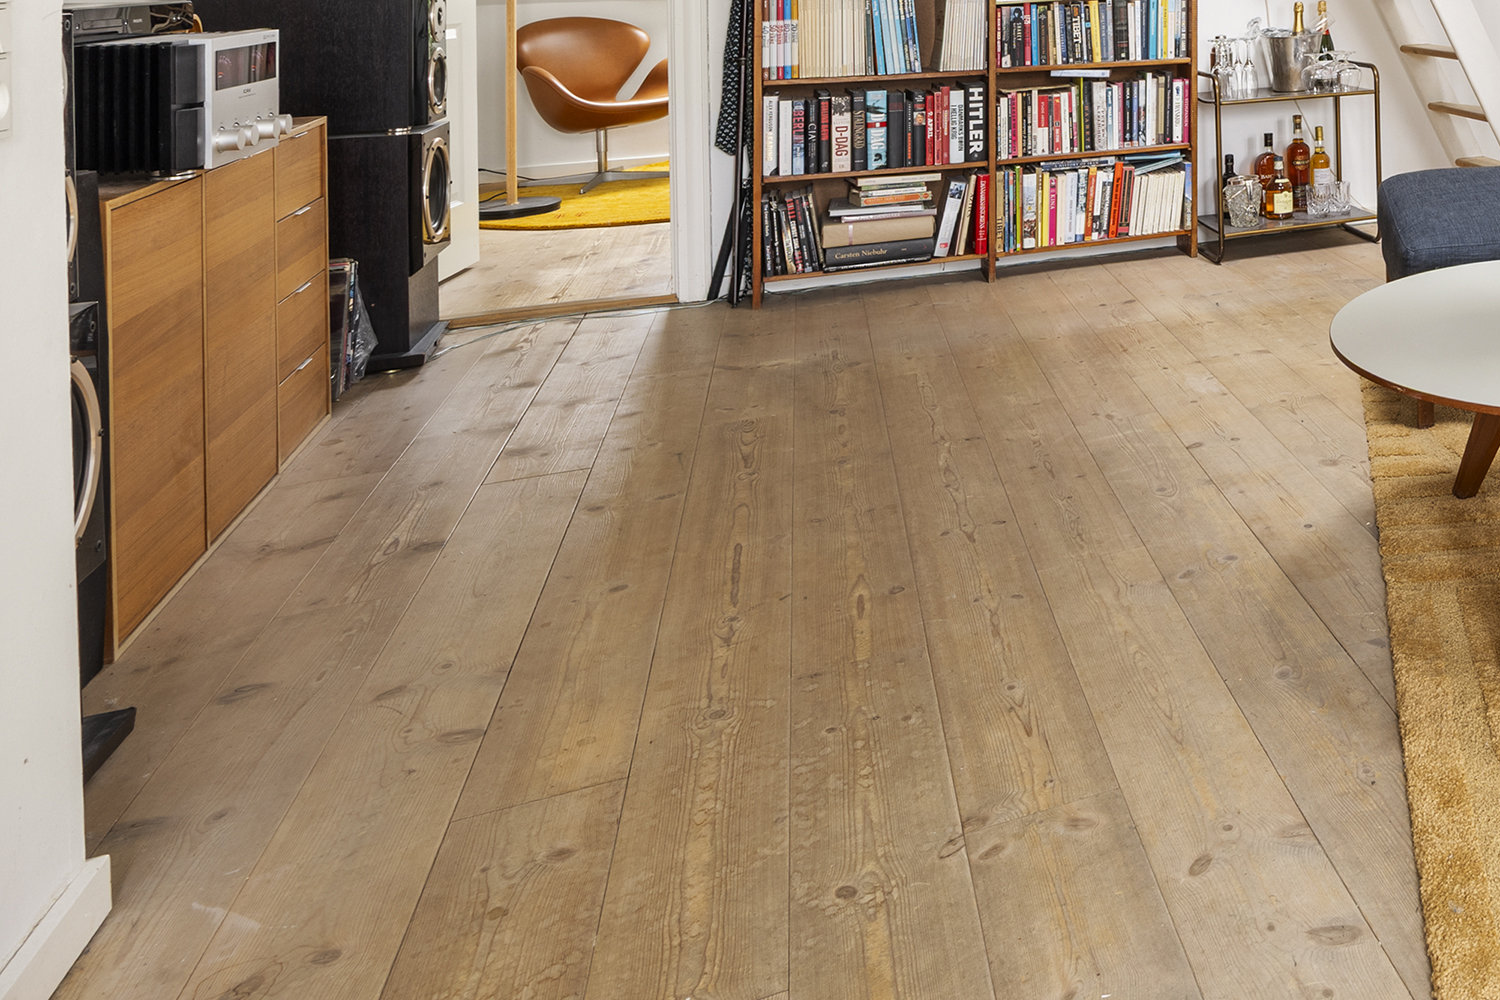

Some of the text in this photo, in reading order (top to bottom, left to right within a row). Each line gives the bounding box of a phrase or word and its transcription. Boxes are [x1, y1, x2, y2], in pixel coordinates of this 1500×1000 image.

[1073, 16, 1081, 44] TIBET
[793, 110, 804, 144] BERLIN
[853, 110, 865, 148] STALINGRAD
[969, 87, 984, 154] HITLER
[835, 125, 849, 157] D-DAG
[835, 249, 888, 260] Carsten Niebuhr
